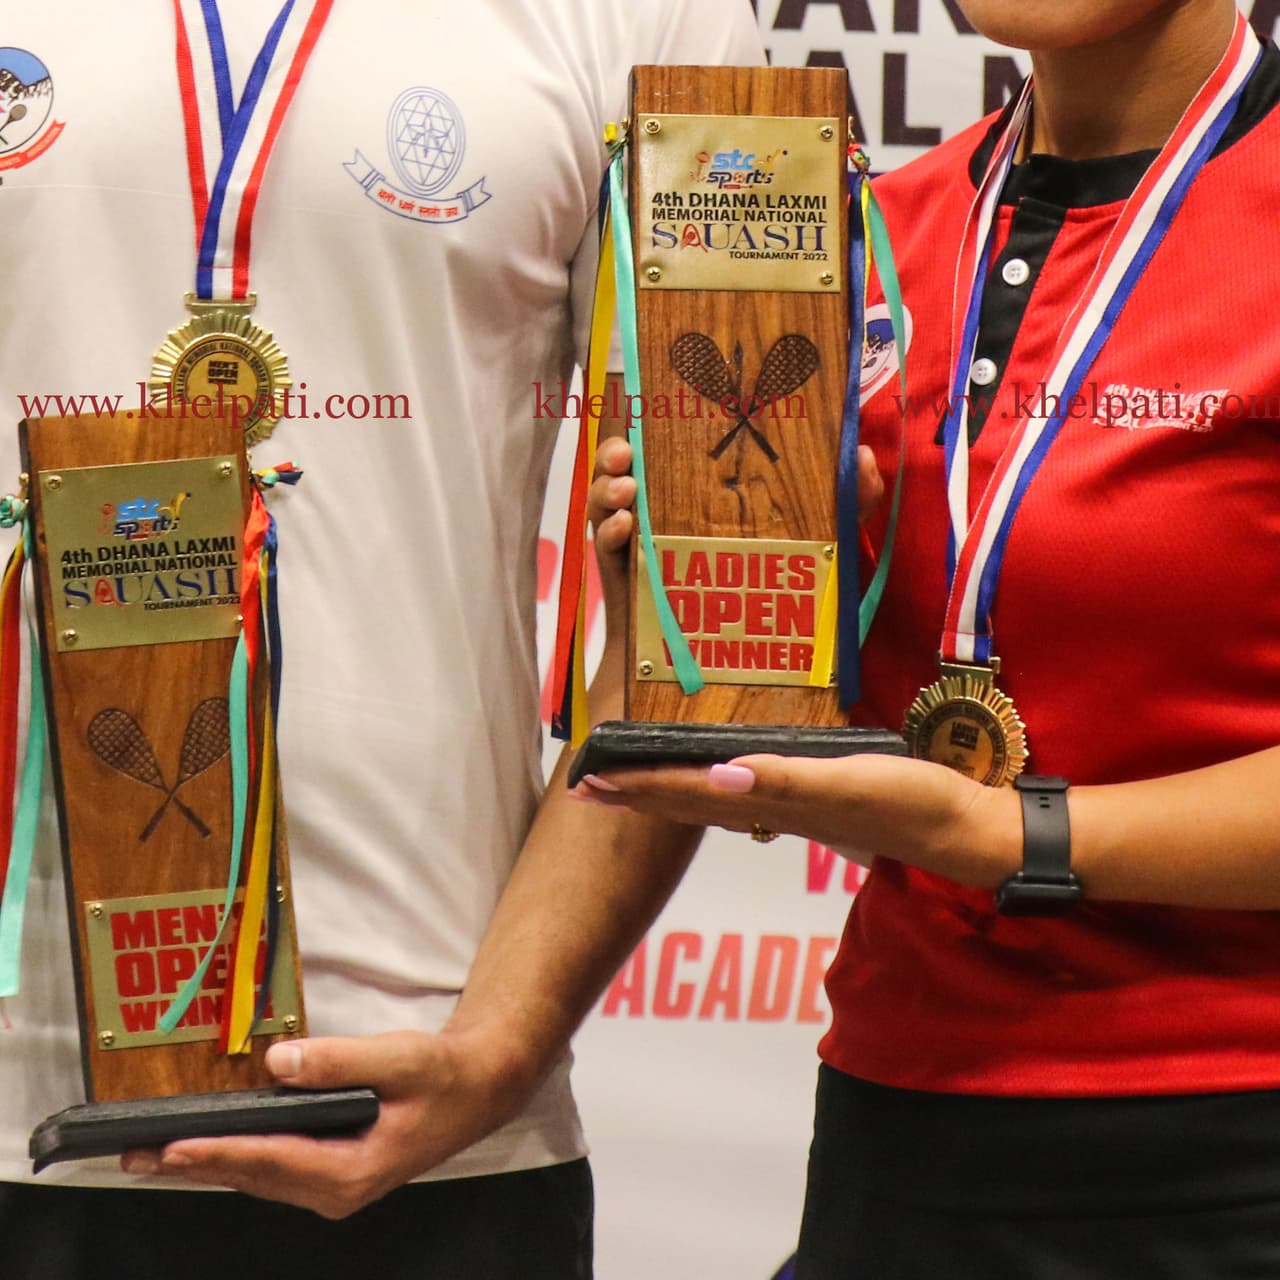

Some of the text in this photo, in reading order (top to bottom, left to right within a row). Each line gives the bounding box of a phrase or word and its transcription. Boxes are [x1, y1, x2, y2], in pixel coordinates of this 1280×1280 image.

[710, 149, 756, 171] stc
[651, 192, 827, 210] 4th DHANA LAXMI
[651, 207, 827, 224] MEMORIAL NATIONAL
[651, 223, 828, 253] SQUASH
[729, 251, 828, 262] TOURNAMENT 2022
[60, 535, 236, 565] 4th DHANA LAXMI
[61, 552, 237, 581] MEMORIAL NATIONAL
[662, 549, 816, 592] LADIES
[63, 567, 240, 609] SQUASH
[143, 597, 215, 612] TOURNAMENT
[665, 589, 816, 639] OPEN
